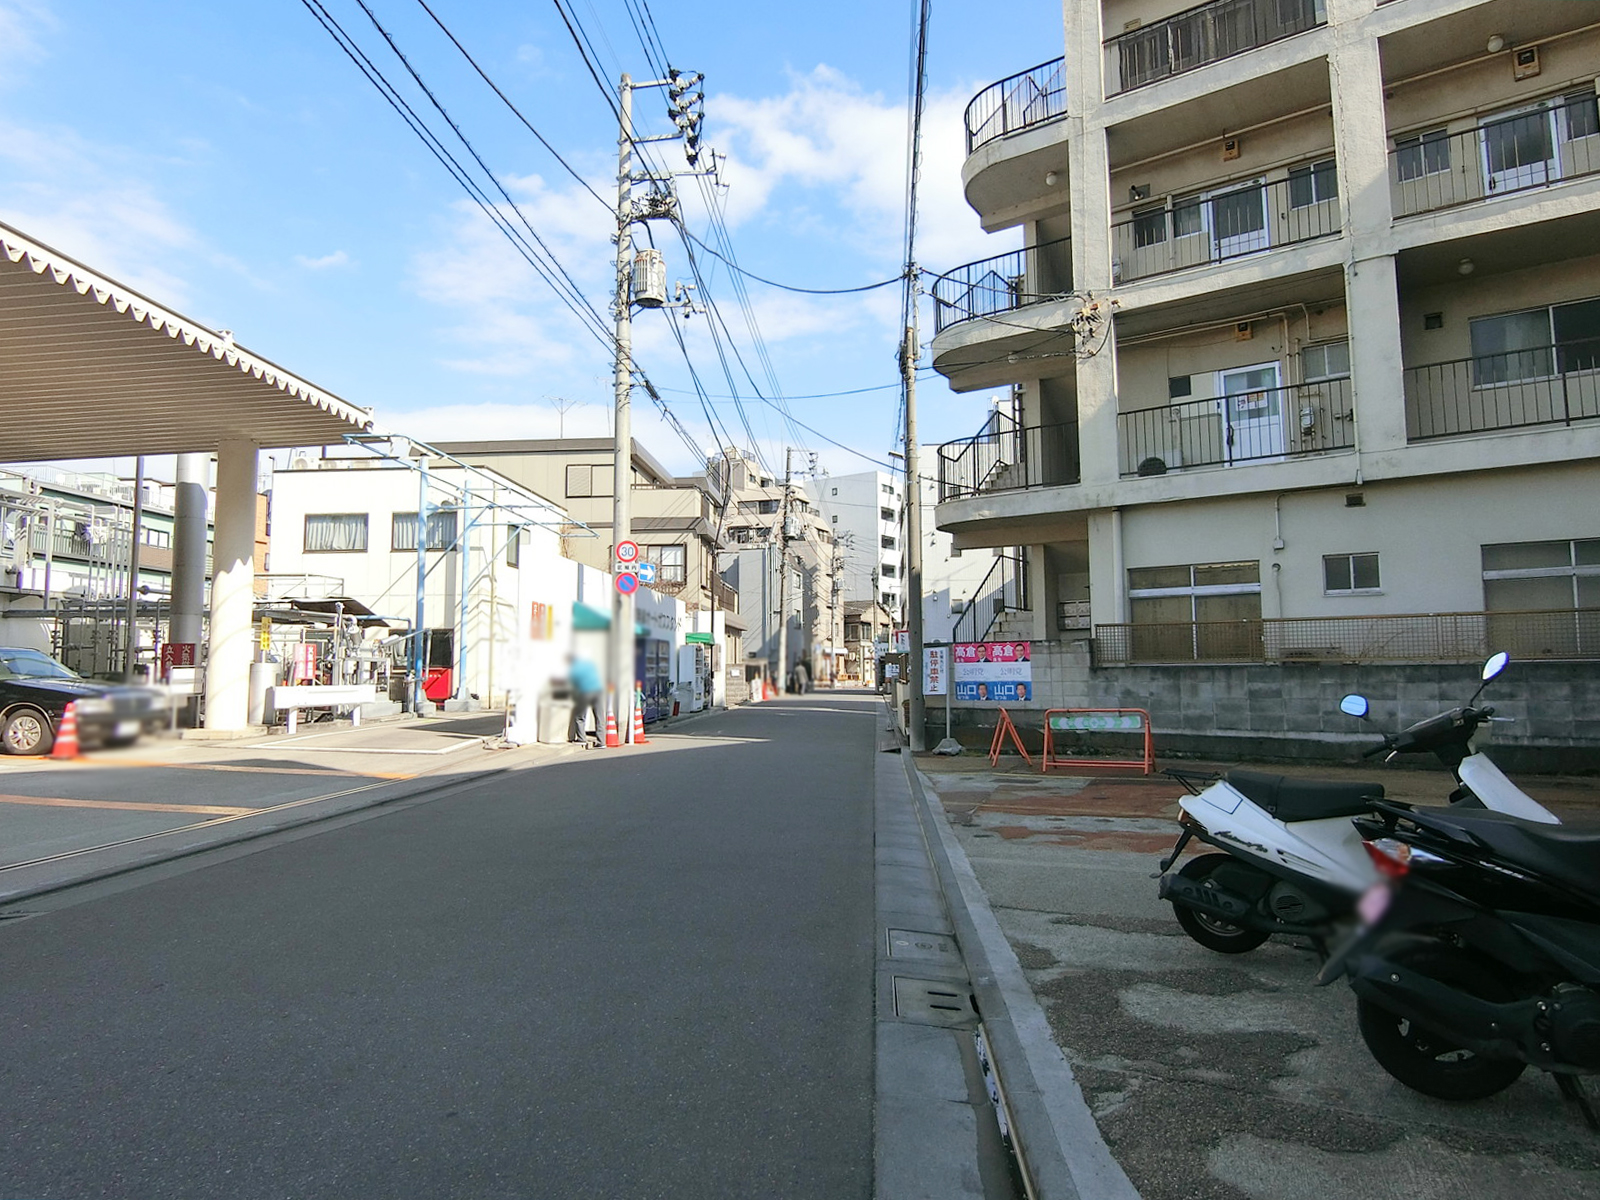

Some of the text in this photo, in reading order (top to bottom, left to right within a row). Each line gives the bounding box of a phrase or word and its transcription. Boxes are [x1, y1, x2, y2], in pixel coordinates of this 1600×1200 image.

[621, 546, 634, 557] 30
[930, 650, 939, 692] 駐停車禁止
[963, 668, 984, 676] 公明党
[1000, 668, 1023, 676] 公明党
[957, 684, 976, 695] 山口
[994, 684, 1015, 695] 山口
